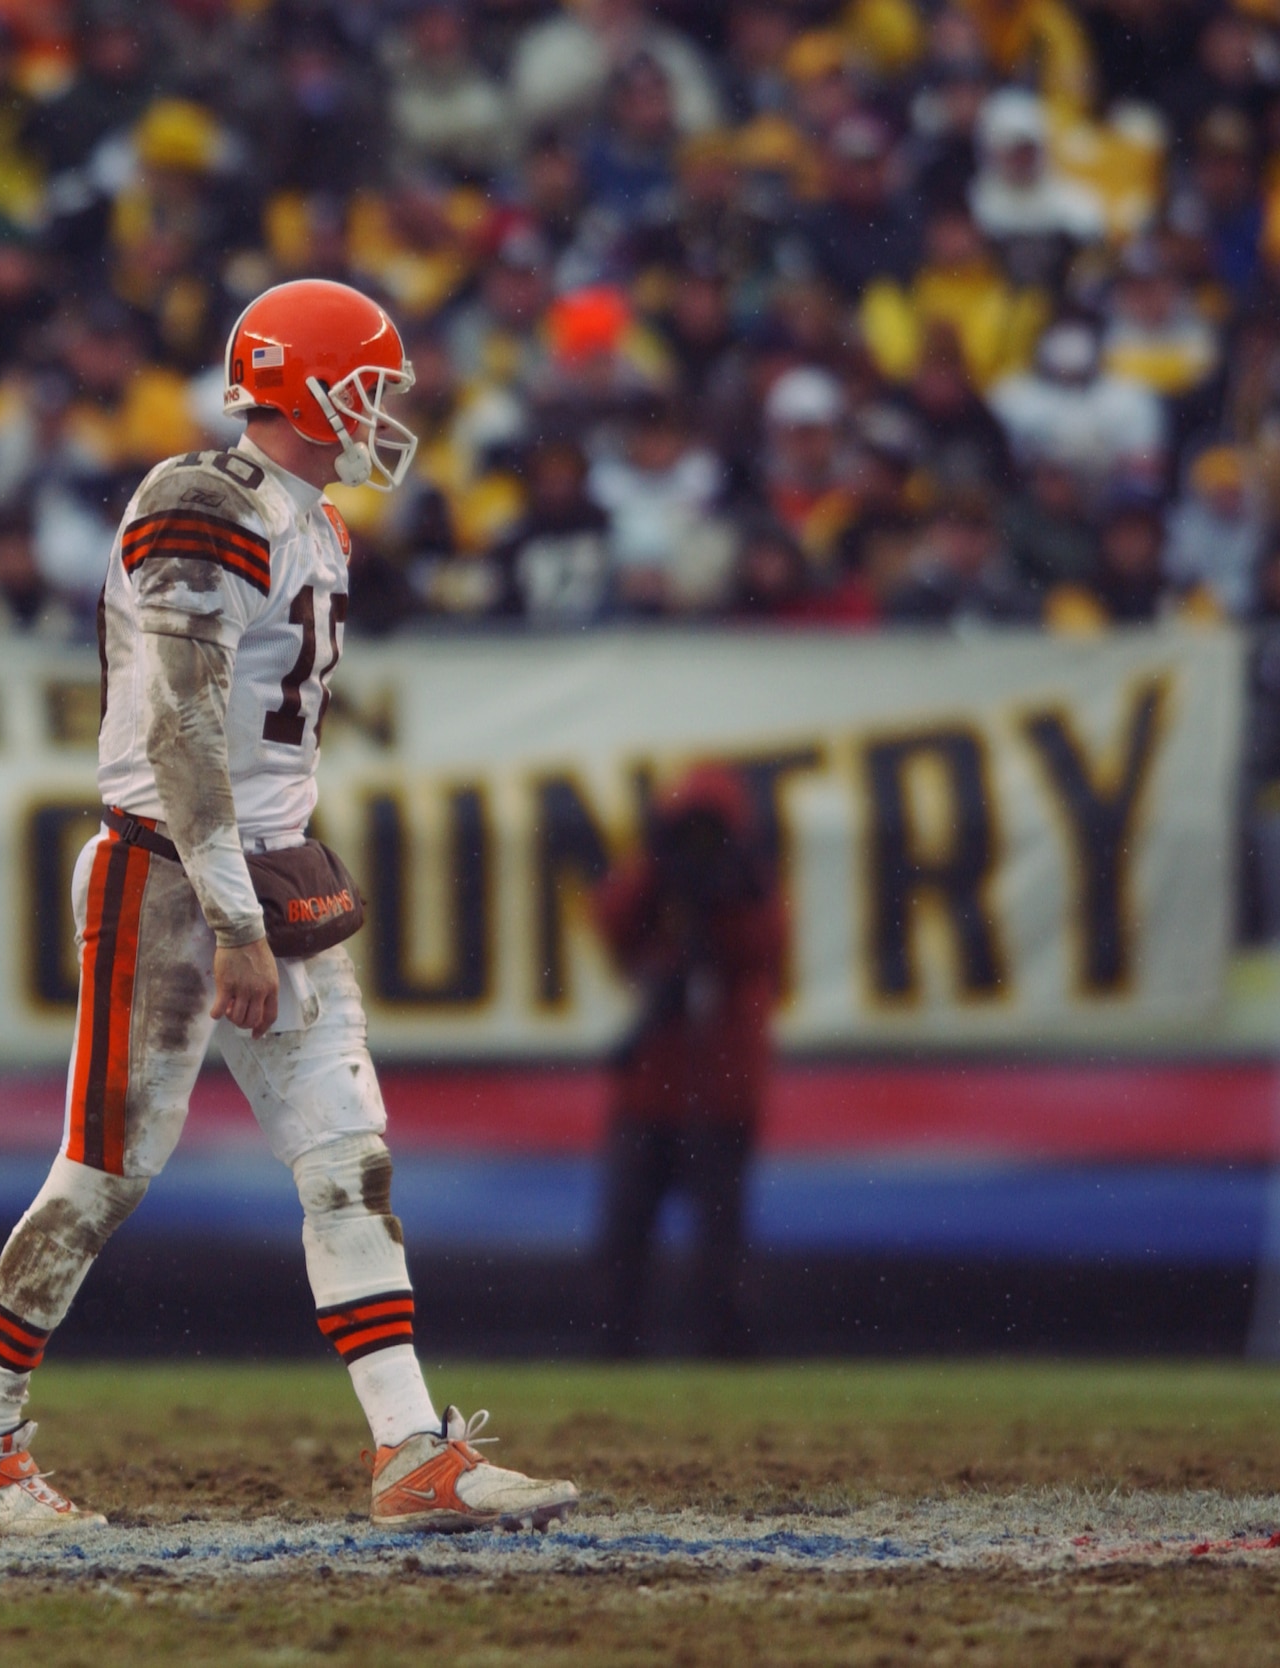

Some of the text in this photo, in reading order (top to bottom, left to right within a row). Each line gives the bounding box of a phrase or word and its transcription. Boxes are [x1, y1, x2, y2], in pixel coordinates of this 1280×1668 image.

[175, 452, 265, 491] 10
[21, 668, 1176, 1018] CUNTRY
[288, 889, 354, 924] BROWNS
